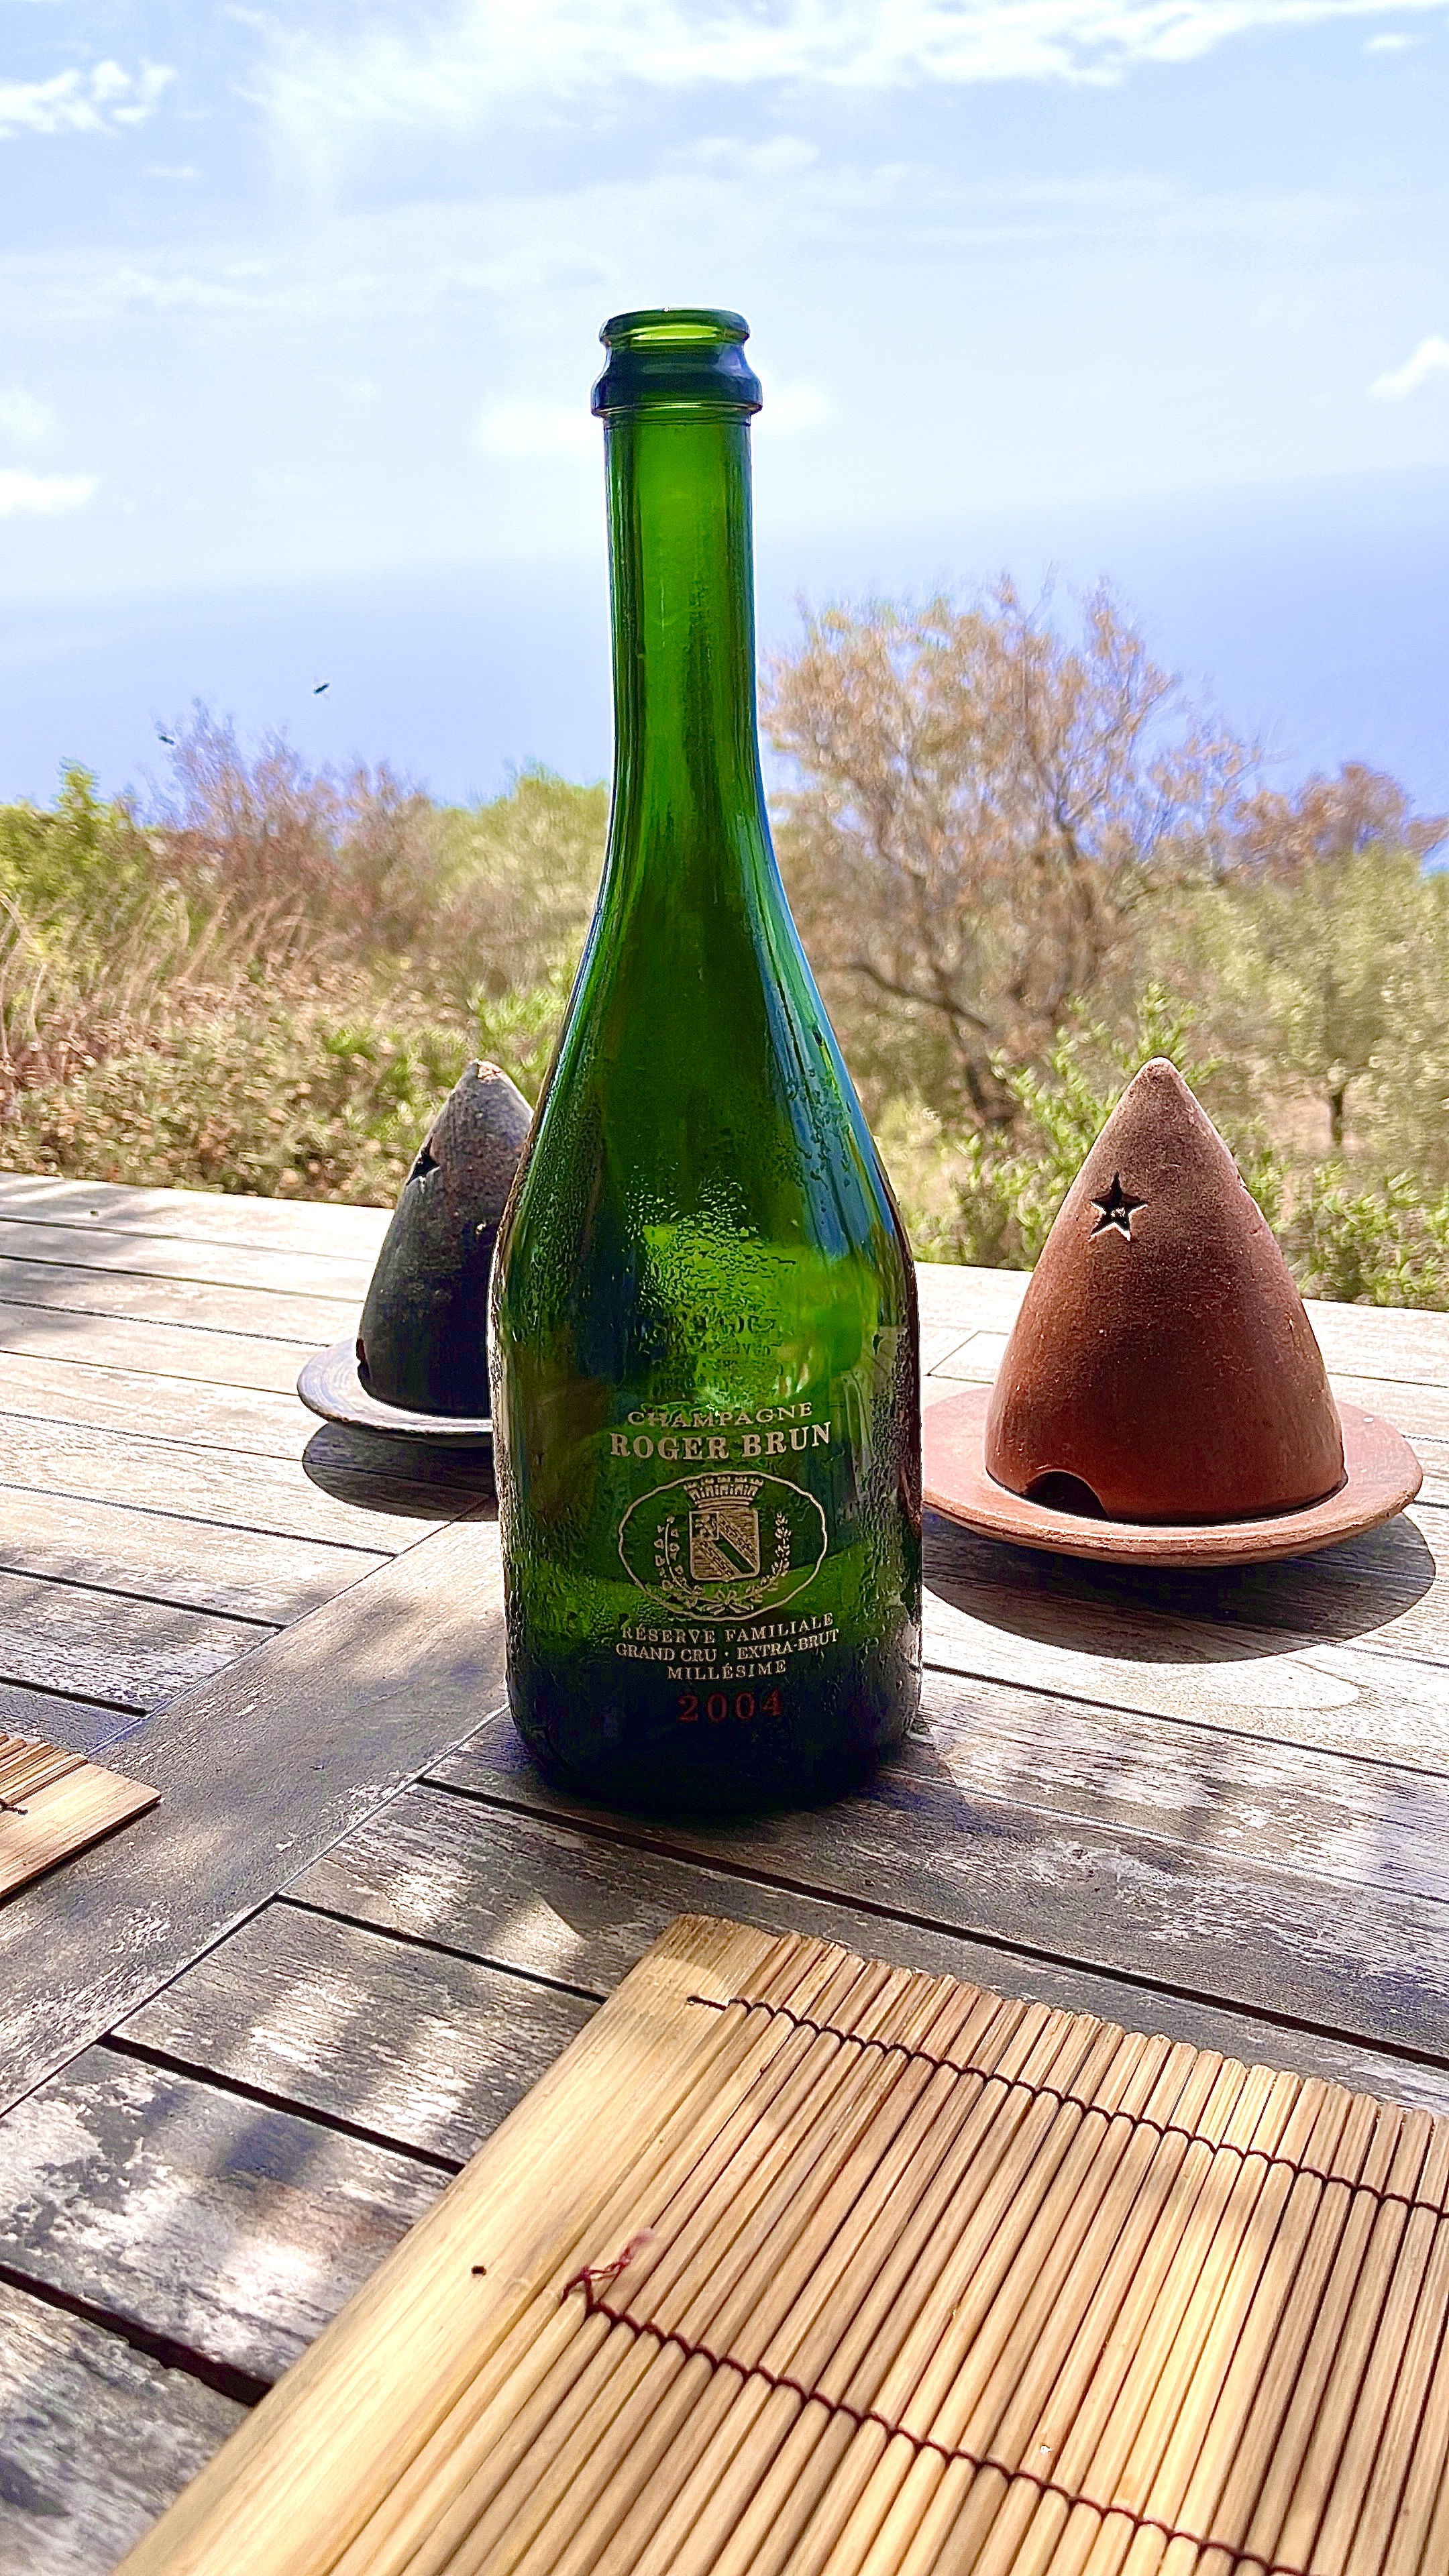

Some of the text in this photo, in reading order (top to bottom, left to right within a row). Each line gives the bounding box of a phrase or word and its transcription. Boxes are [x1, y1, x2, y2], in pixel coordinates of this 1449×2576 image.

[627, 1401, 813, 1428] CHAMPAGNE
[609, 1421, 831, 1460] ROGER BRUN
[621, 1612, 834, 1644] RÉSERVE FAMILIALE
[615, 1643, 676, 1661] GRAND
[680, 1648, 717, 1662] CRU
[737, 1628, 839, 1660] EXTRA-BRUT
[667, 1659, 787, 1680] MILLÉSIME
[676, 1687, 784, 1723] 2004
